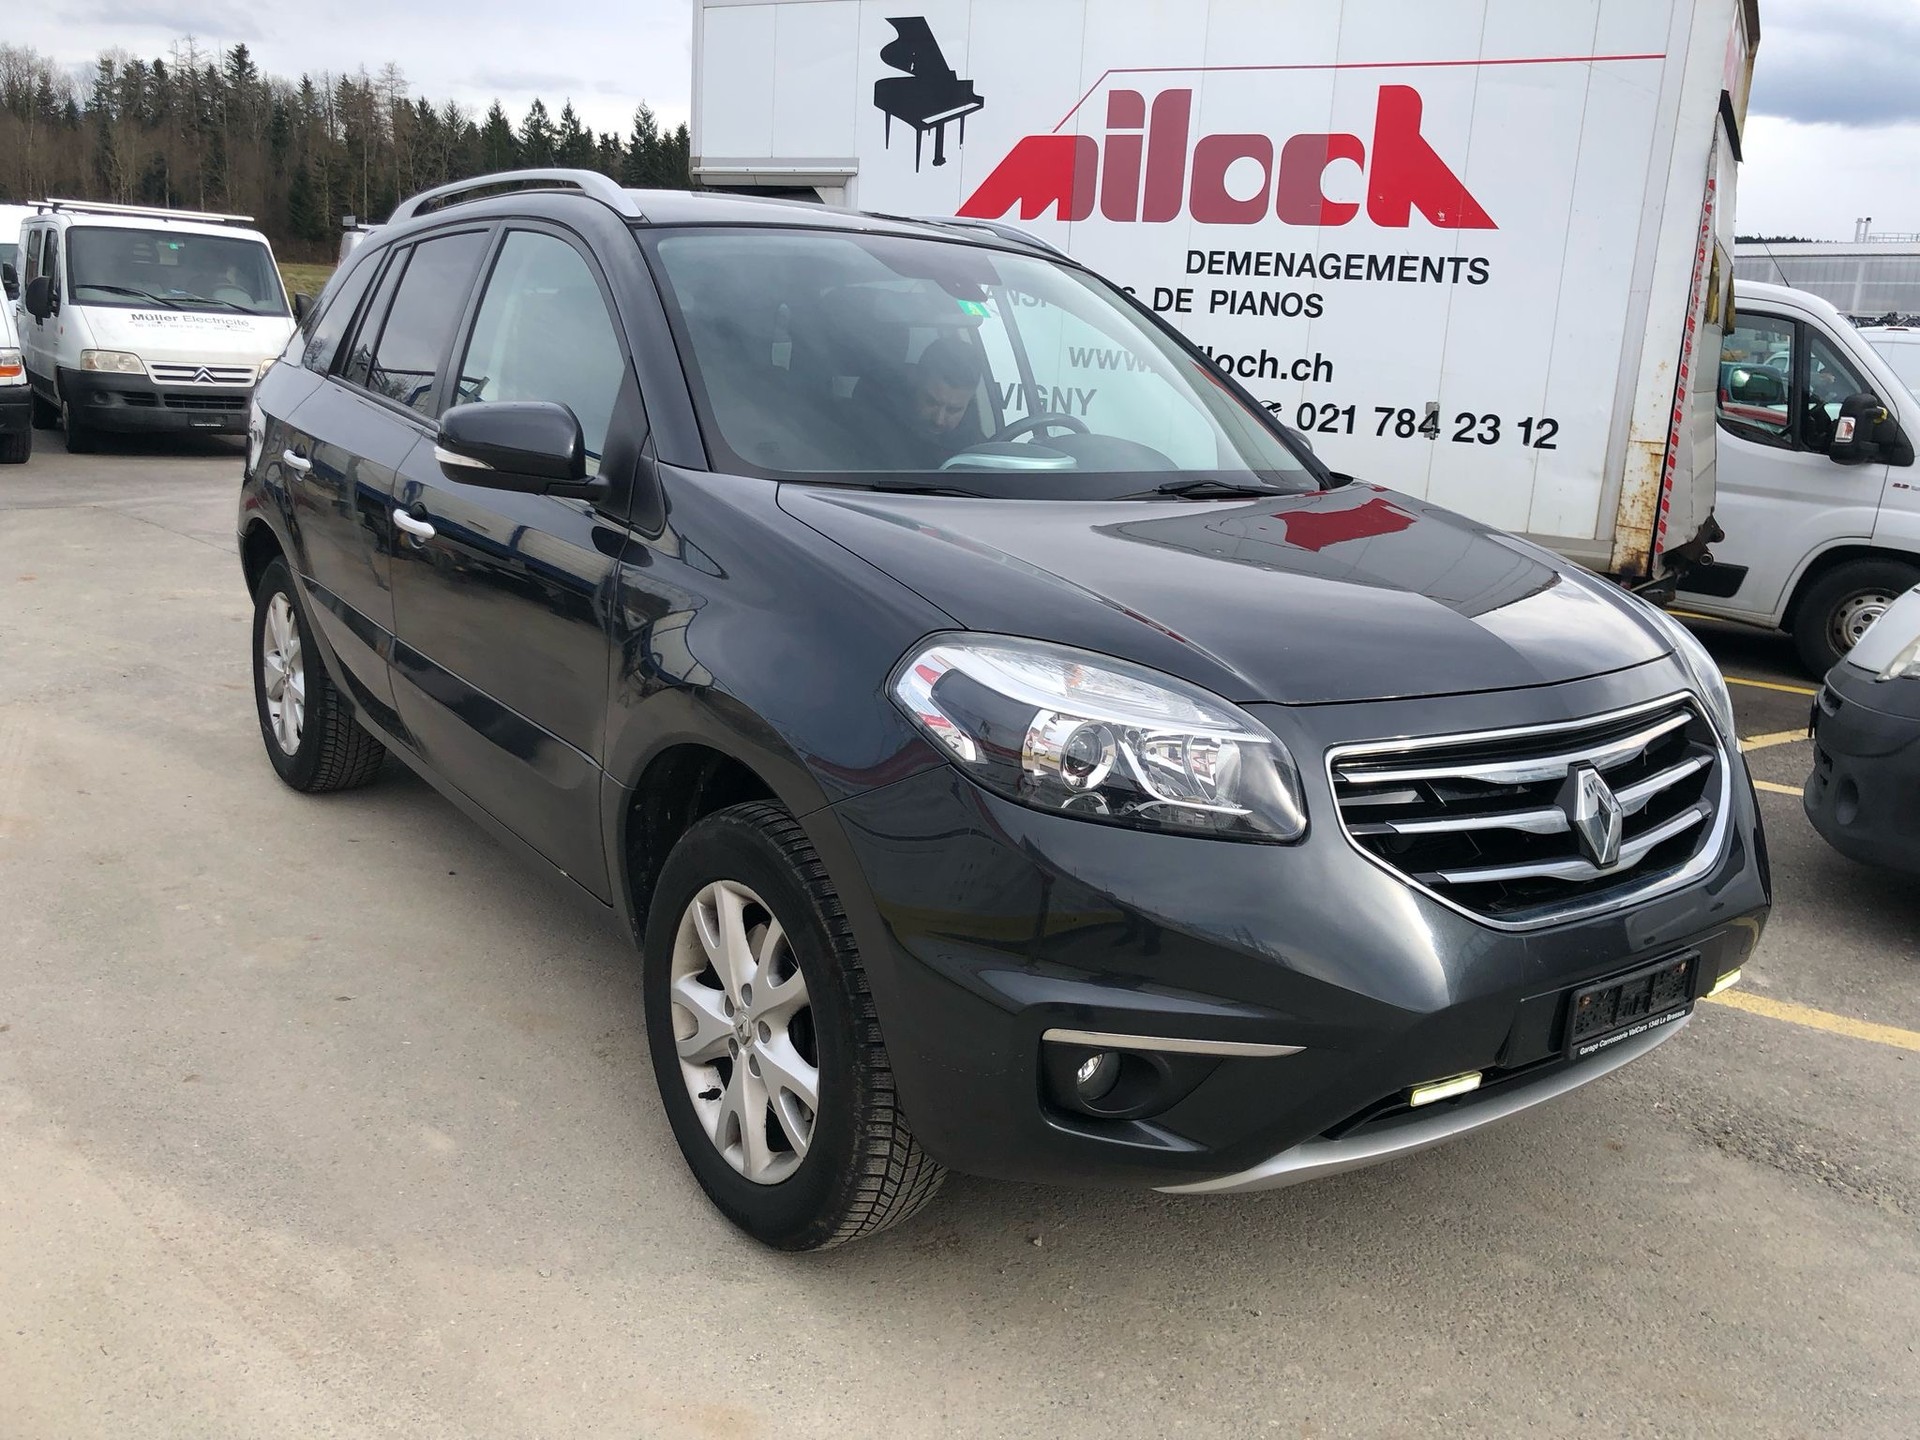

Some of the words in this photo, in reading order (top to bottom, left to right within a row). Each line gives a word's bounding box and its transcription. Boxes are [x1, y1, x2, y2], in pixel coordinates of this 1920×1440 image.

[1185, 250, 1490, 285] DEMENAGEMENTS
[1153, 287, 1194, 313] DE
[1209, 289, 1324, 318] PIANOS
[131, 313, 178, 322] Müller
[182, 315, 250, 327] Electricité
[1296, 402, 1356, 435] 021
[1374, 406, 1440, 440] 784
[1451, 412, 1501, 445] 23
[1517, 416, 1560, 450] 12
[1580, 1043, 1599, 1055] Garage
[1599, 1031, 1629, 1048] Carrosserie
